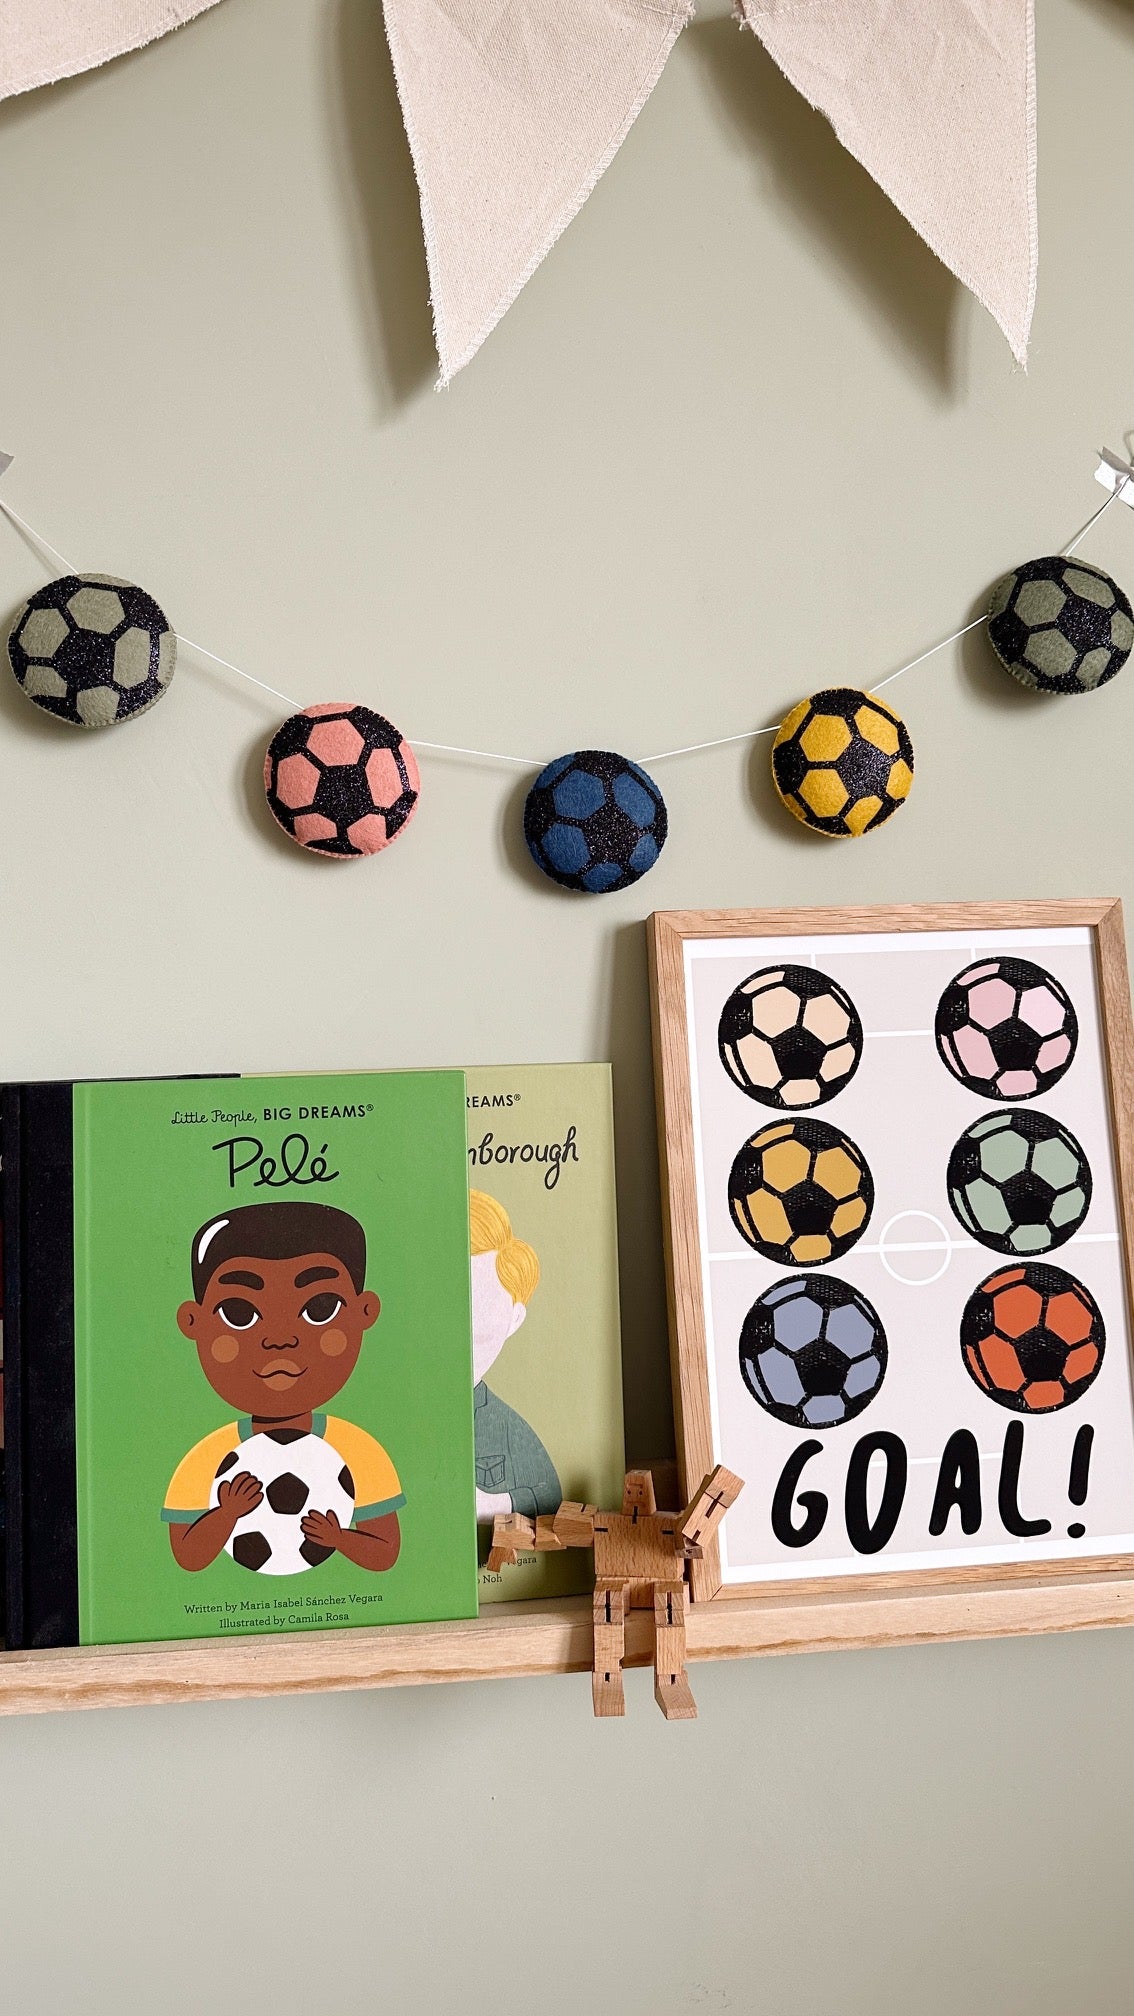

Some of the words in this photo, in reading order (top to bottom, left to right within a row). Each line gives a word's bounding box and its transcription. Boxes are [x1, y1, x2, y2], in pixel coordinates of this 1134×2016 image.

[171, 1110, 209, 1125] Little
[211, 1109, 258, 1127] People,
[263, 1107, 292, 1121] BIG
[211, 1133, 340, 1188] Pelé
[771, 1420, 1095, 1555] GOAL!
[184, 1604, 223, 1614] Written
[225, 1602, 238, 1613] by
[240, 1600, 271, 1611] Maria
[273, 1597, 303, 1609] Isabel
[305, 1595, 347, 1607] Sánchez
[348, 1593, 384, 1604] Vegara
[219, 1615, 271, 1629] Illustrated
[273, 1614, 286, 1627] by
[288, 1612, 323, 1625] Camila
[326, 1612, 350, 1622] Rosa
